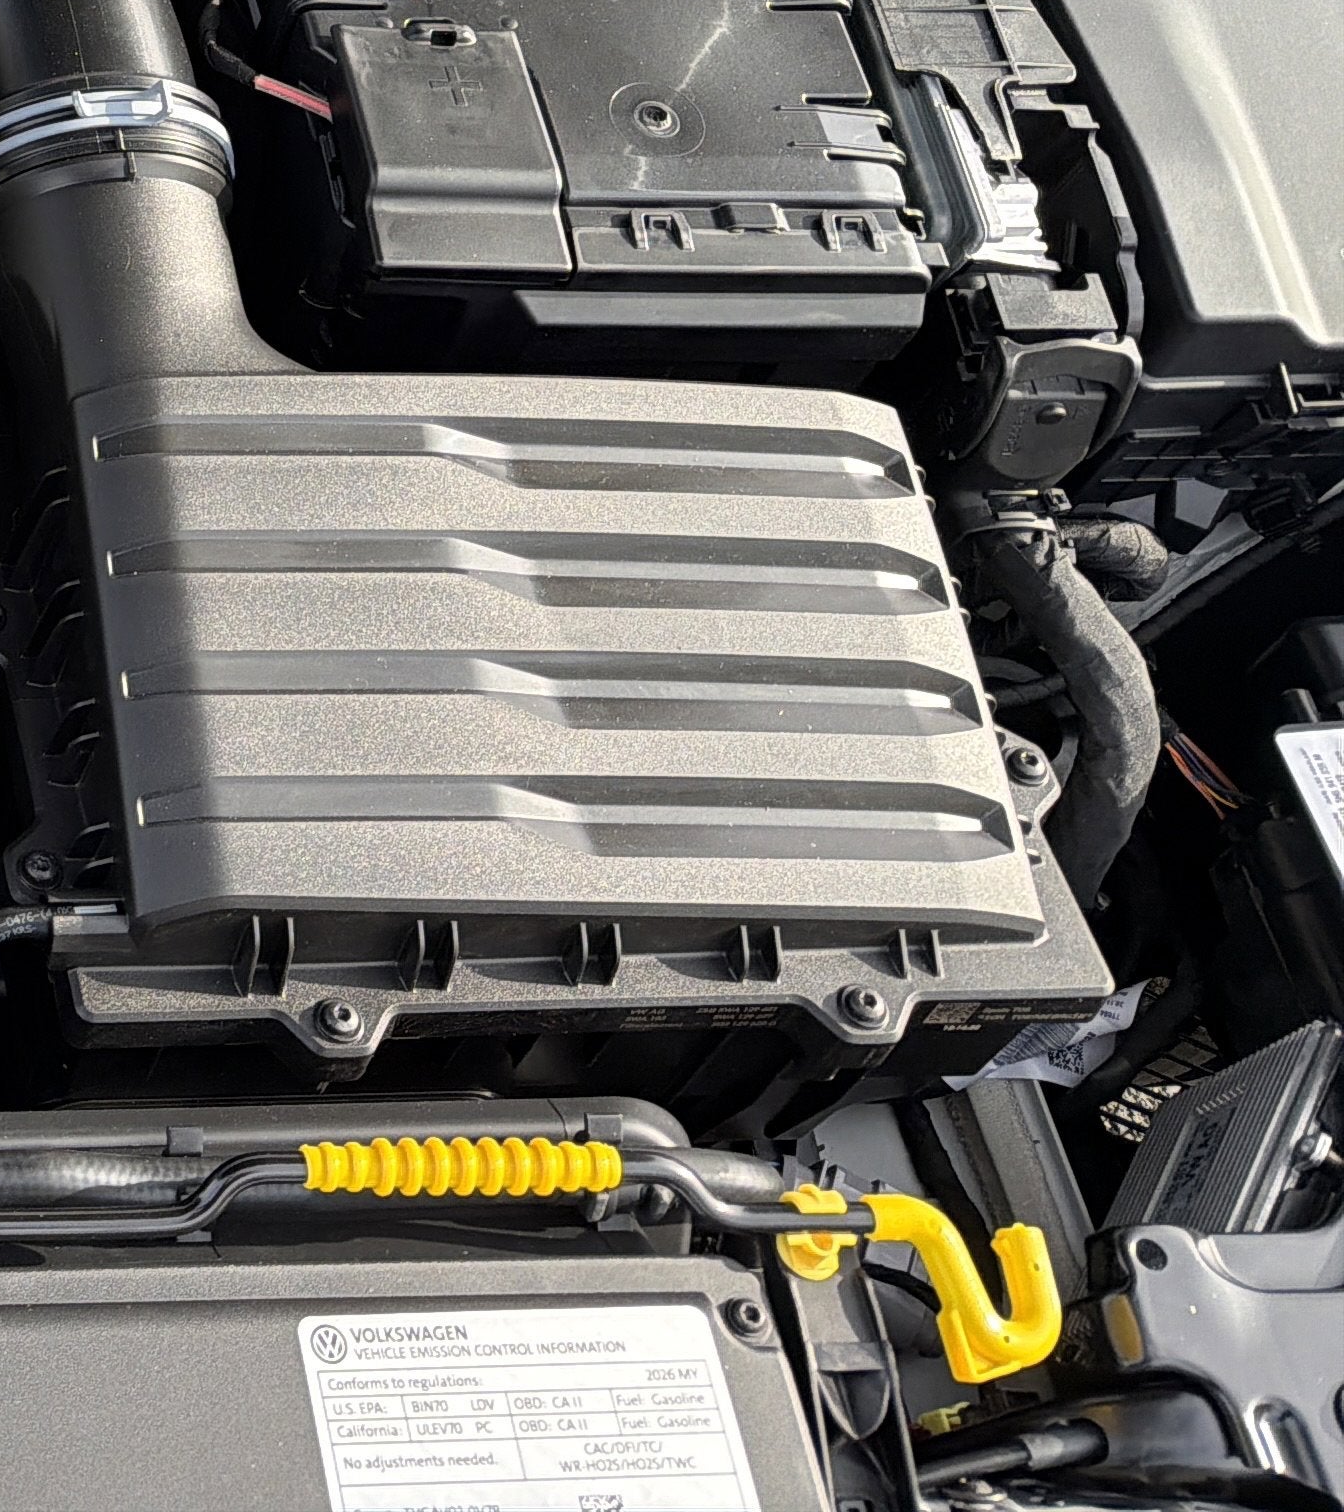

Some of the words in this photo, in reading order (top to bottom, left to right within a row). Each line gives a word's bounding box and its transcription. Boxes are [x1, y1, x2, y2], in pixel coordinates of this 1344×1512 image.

[349, 1325, 468, 1343] VOLKSWAGEN
[354, 1346, 406, 1360] VEHICLE
[410, 1345, 472, 1359] EMISSION
[474, 1343, 534, 1357] CONTROL
[537, 1341, 626, 1354] INFORMATION
[327, 1377, 389, 1391] Conforms
[391, 1378, 405, 1389] to
[408, 1375, 483, 1391] regulations:
[645, 1368, 675, 1381] 2026
[679, 1368, 698, 1379] MY
[333, 1403, 356, 1415] U.S.
[359, 1402, 388, 1415] EPA:
[411, 1400, 449, 1413] BIN70
[471, 1399, 495, 1411] LDV
[513, 1396, 548, 1410] OBD:
[552, 1396, 572, 1409] CA
[616, 1394, 644, 1407] Fuel:
[651, 1393, 705, 1405] Gasoline
[337, 1425, 403, 1438] California:
[416, 1422, 463, 1436] ULEV70
[476, 1421, 493, 1434] PC
[519, 1419, 552, 1432] OBD:
[558, 1419, 577, 1431] CA
[621, 1417, 651, 1429] Fuel:
[657, 1416, 711, 1428] Gasoline
[343, 1457, 362, 1470] No
[365, 1455, 445, 1472] adjustments
[447, 1452, 498, 1466] needed.
